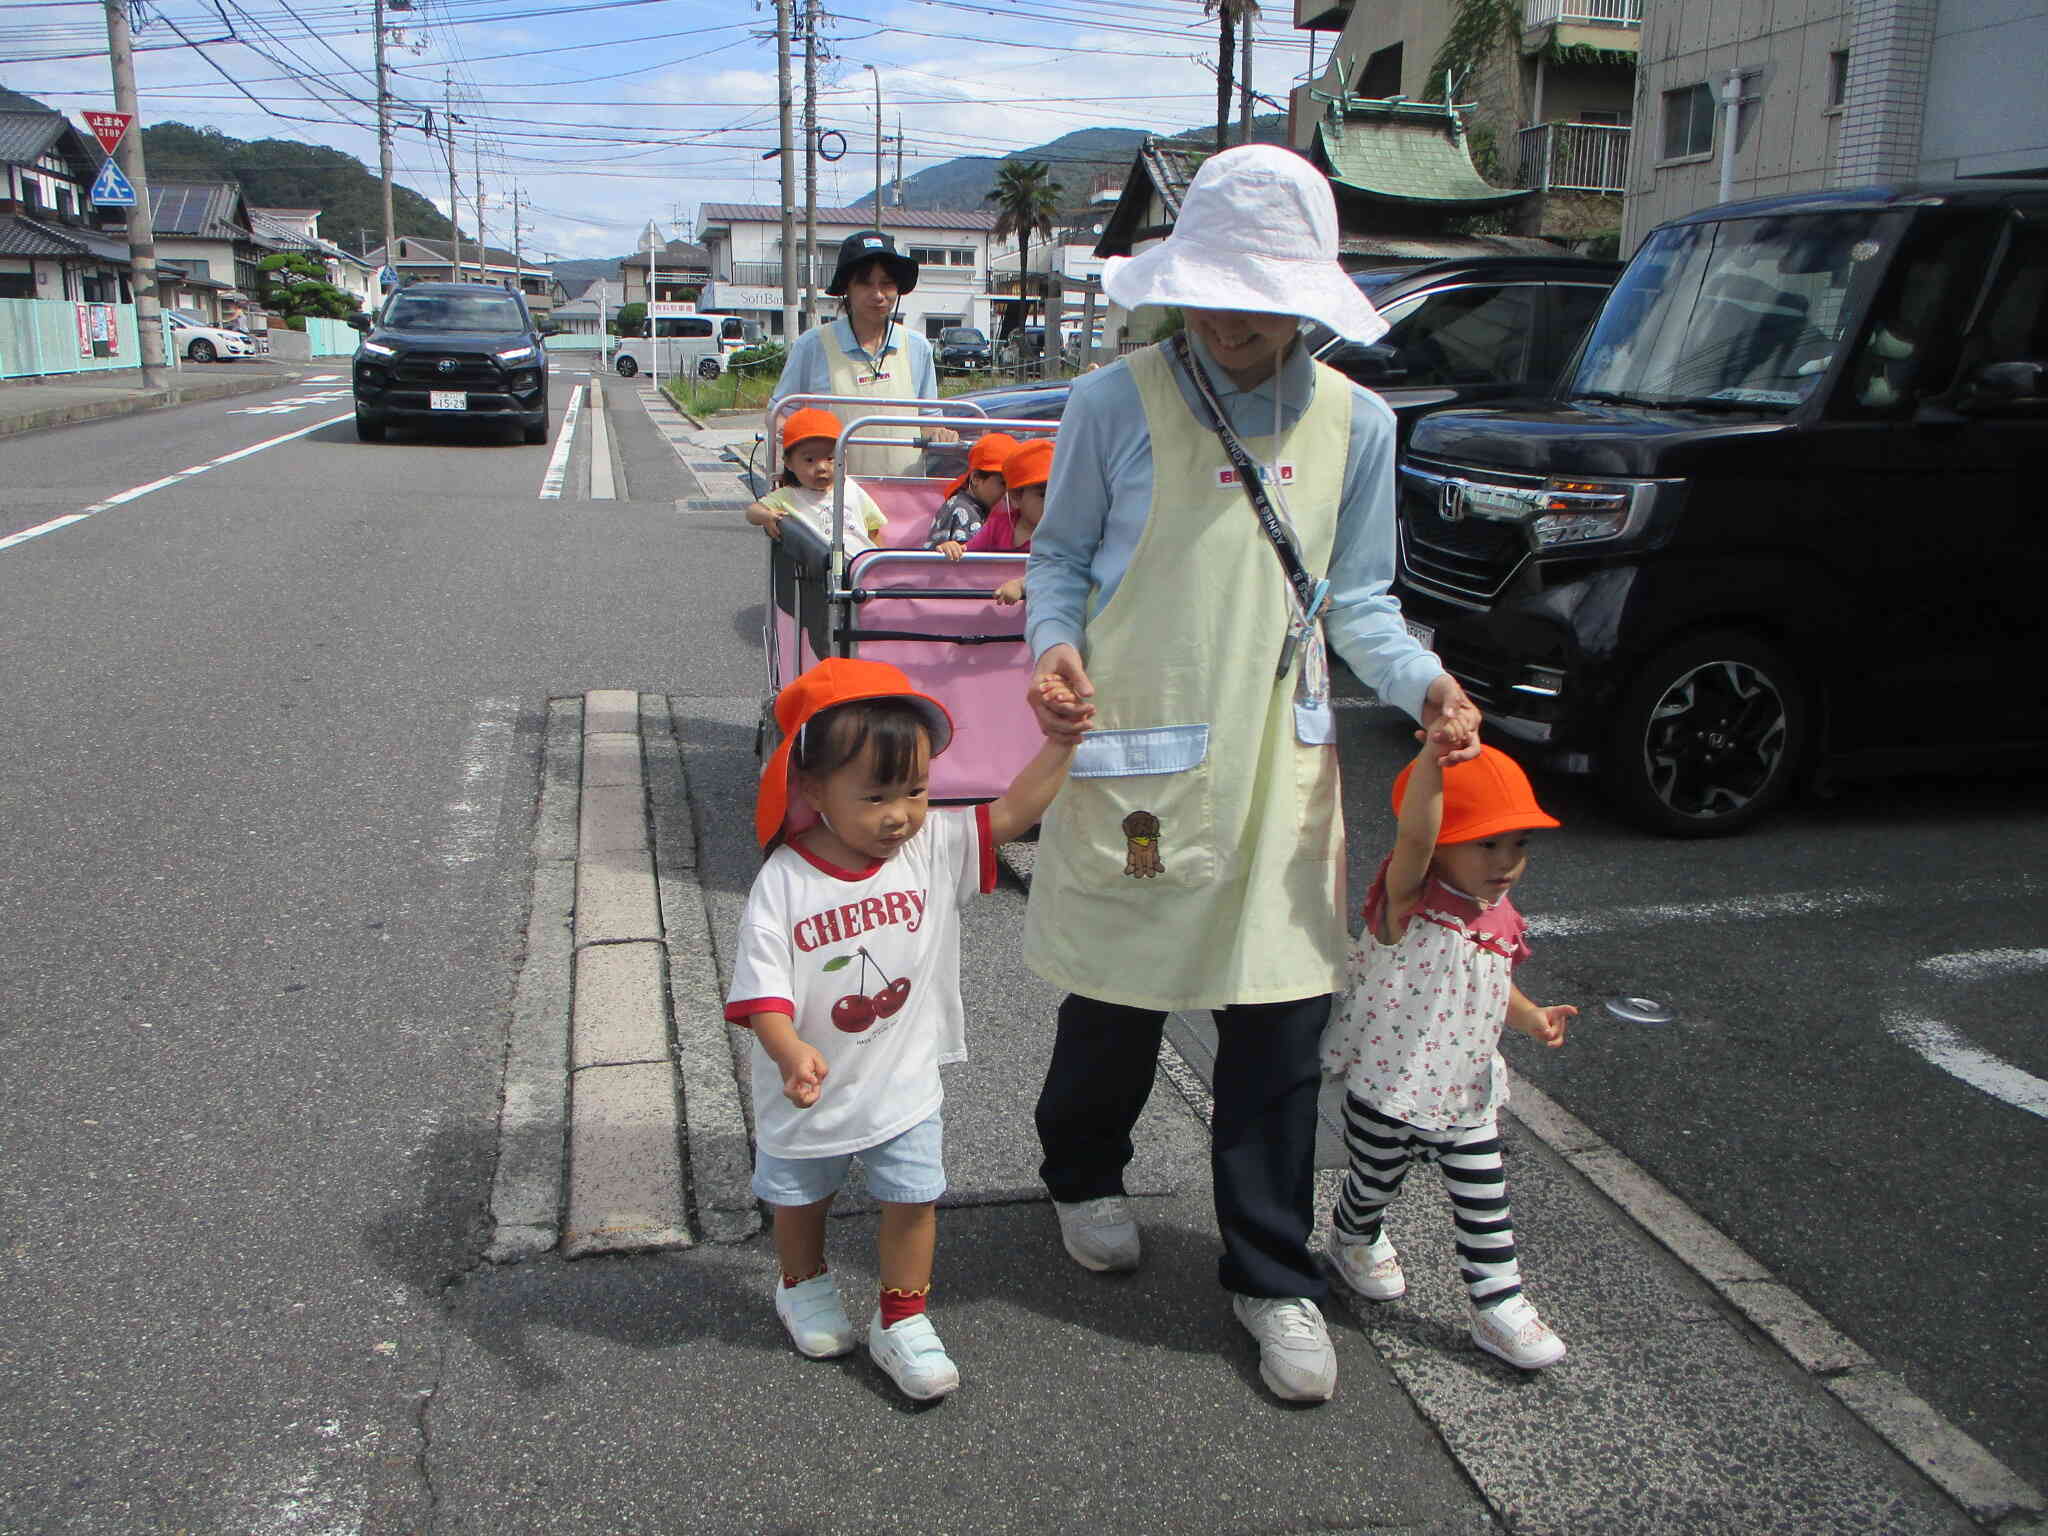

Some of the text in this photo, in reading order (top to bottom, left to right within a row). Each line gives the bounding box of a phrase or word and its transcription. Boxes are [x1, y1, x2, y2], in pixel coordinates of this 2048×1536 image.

[93, 116, 124, 127] 止まれ
[99, 128, 120, 137] STOP
[740, 291, 783, 304] SoftBa
[1261, 505, 1288, 544] AGNES
[793, 888, 927, 952] CHERRY
